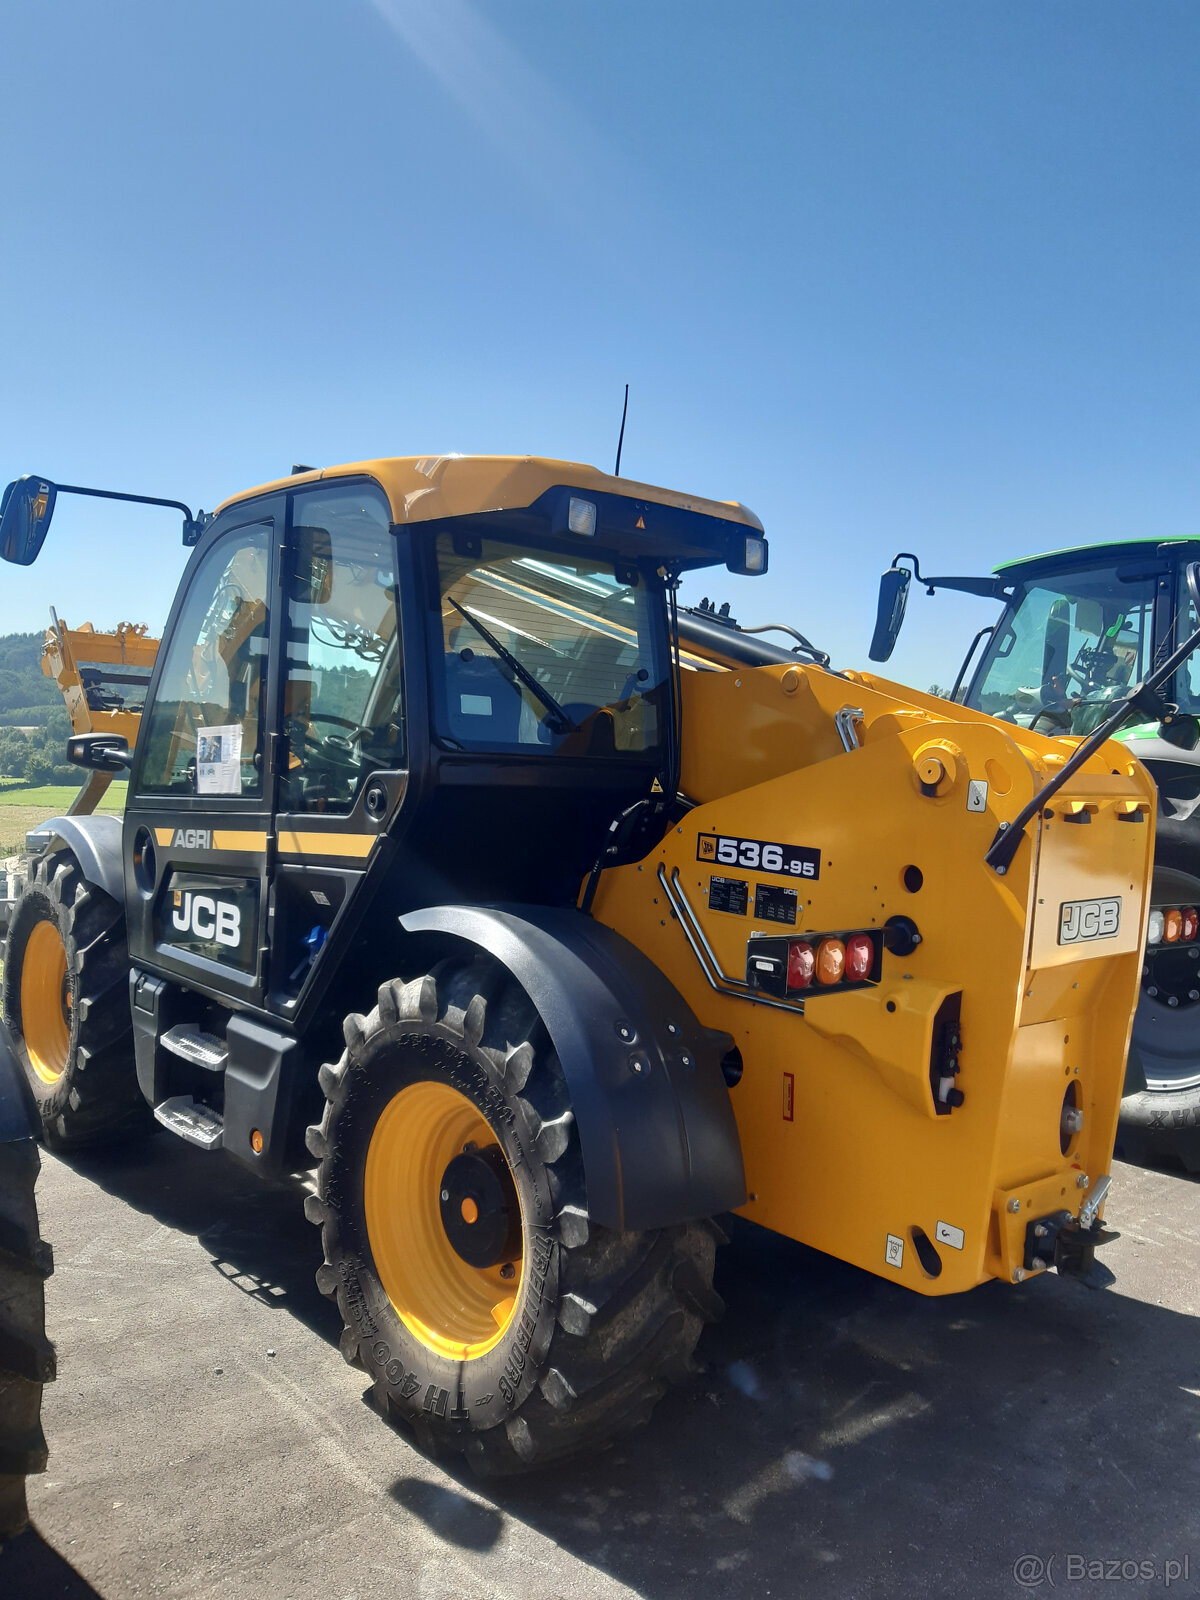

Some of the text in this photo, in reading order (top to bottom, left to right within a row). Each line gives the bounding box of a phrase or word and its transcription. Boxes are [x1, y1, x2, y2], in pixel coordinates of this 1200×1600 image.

[174, 829, 211, 849] AGRI
[172, 892, 241, 948] JCB
[1062, 901, 1120, 940] JCB
[499, 1233, 554, 1403] TRELLEBORG
[373, 1341, 422, 1398] 400
[422, 1383, 469, 1419] TH
